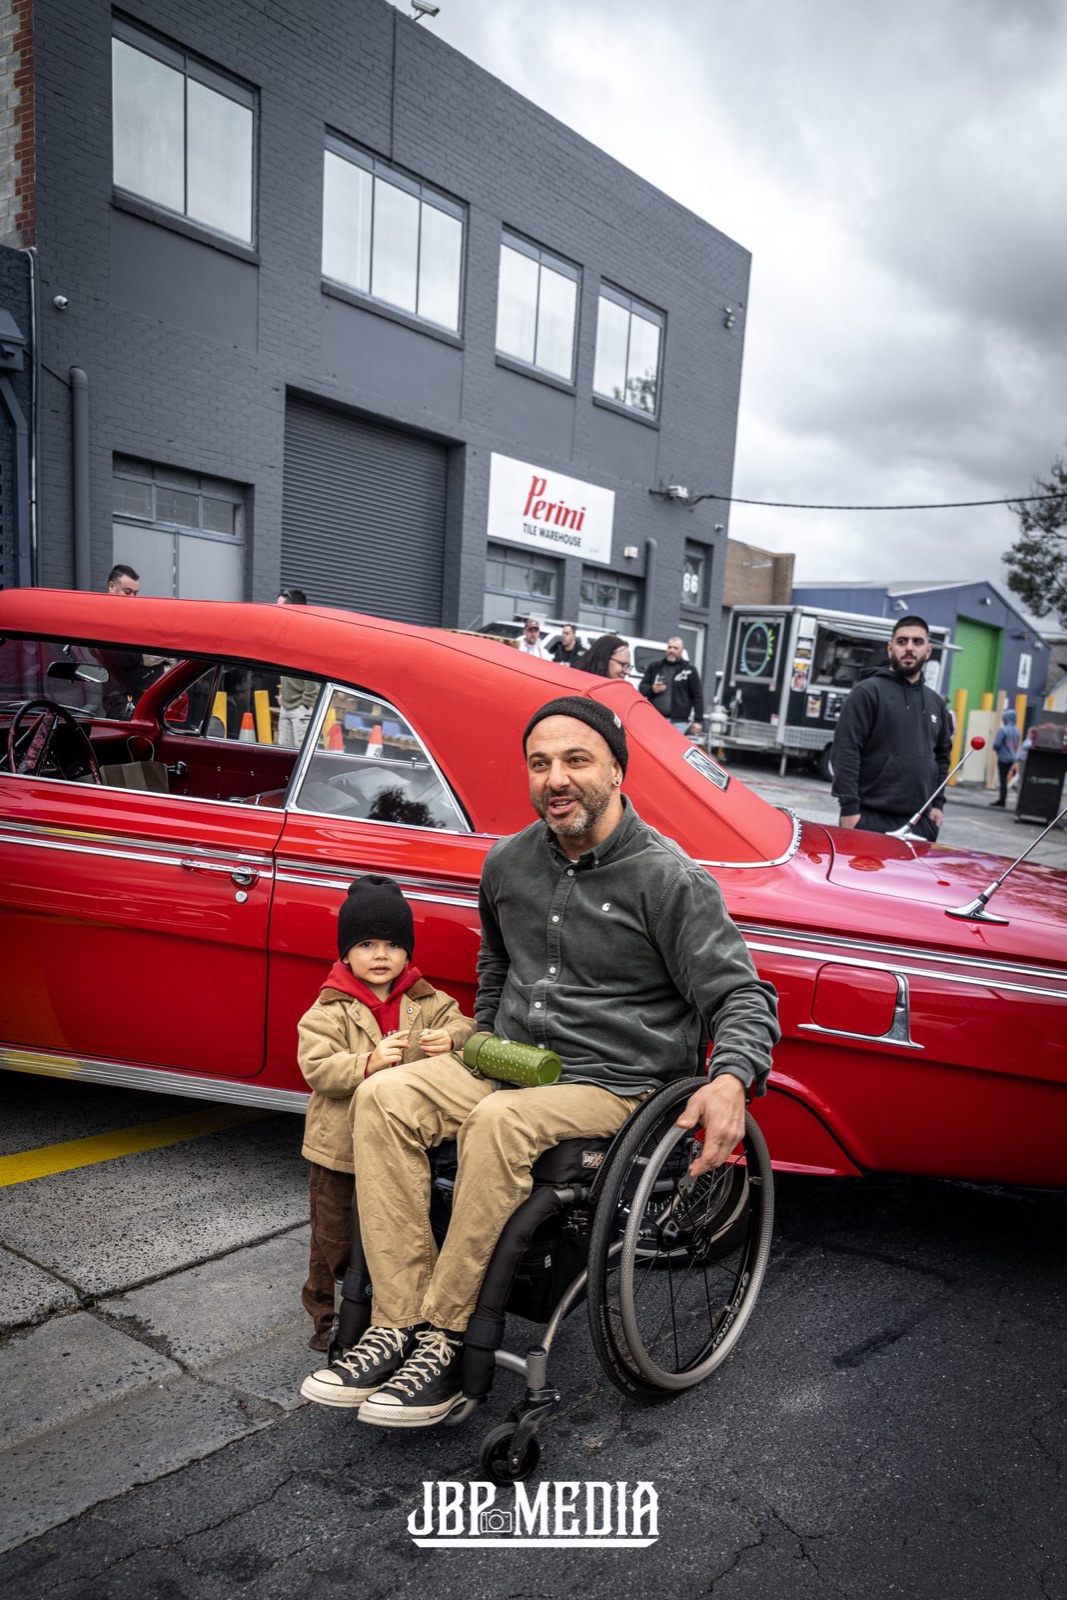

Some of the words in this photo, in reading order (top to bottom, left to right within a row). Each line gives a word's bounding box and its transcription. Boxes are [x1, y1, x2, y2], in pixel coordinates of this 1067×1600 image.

[523, 475, 586, 531] Perini
[523, 522, 537, 536] TILE
[539, 527, 582, 547] WAREHOUSE
[682, 572, 699, 594] 66
